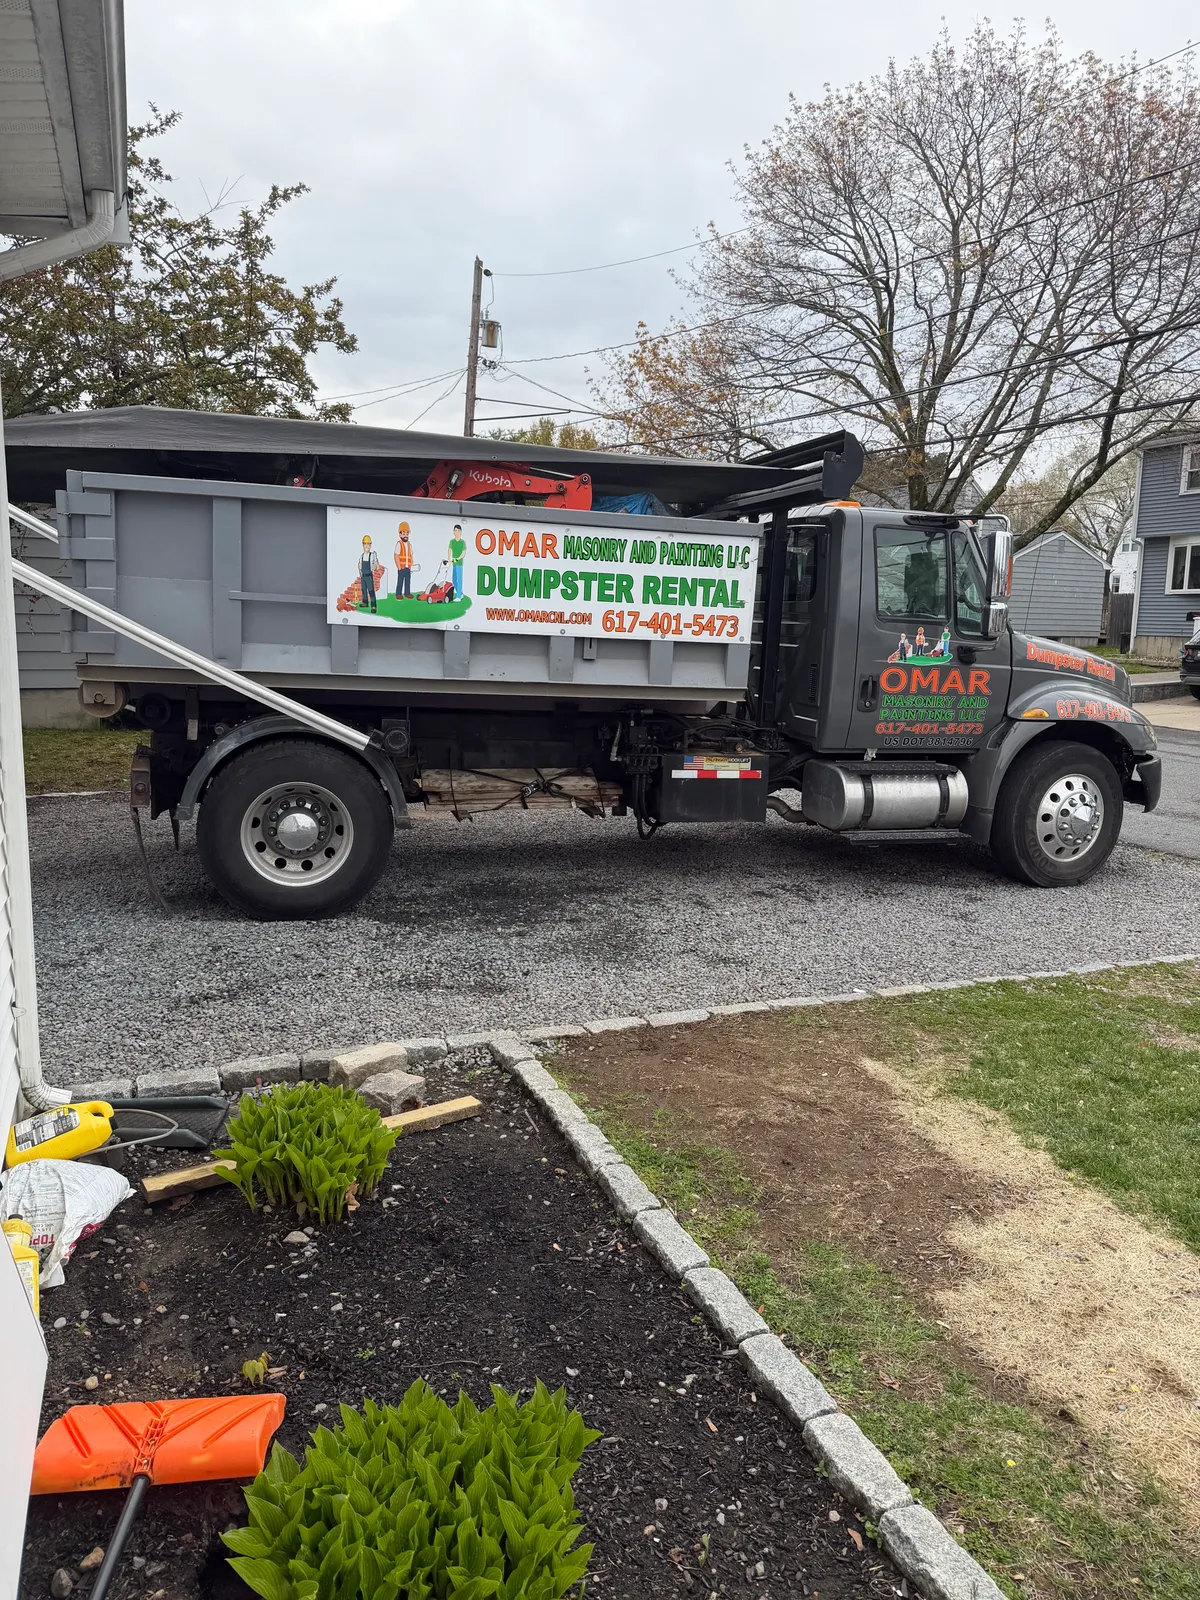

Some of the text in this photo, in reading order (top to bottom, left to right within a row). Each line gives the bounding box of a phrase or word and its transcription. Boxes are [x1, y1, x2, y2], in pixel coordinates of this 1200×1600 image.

[469, 470, 512, 488] Kubota
[475, 528, 750, 569] OMAR MASONRY AND PAINTING LLC
[476, 565, 745, 608] DUMPSTER RENTAL
[485, 607, 739, 638] WWW.OMARCNL.COM 617-401-5473
[1026, 641, 1116, 681] Dumpster Rental
[879, 666, 992, 695] OMAR
[882, 695, 990, 709] MASONRY AND
[1055, 699, 1132, 723] 617-401-5473
[879, 708, 986, 721] PAINTING LLC
[874, 721, 984, 735] 617-401-5473
[883, 736, 974, 747] US DOT 3814796
